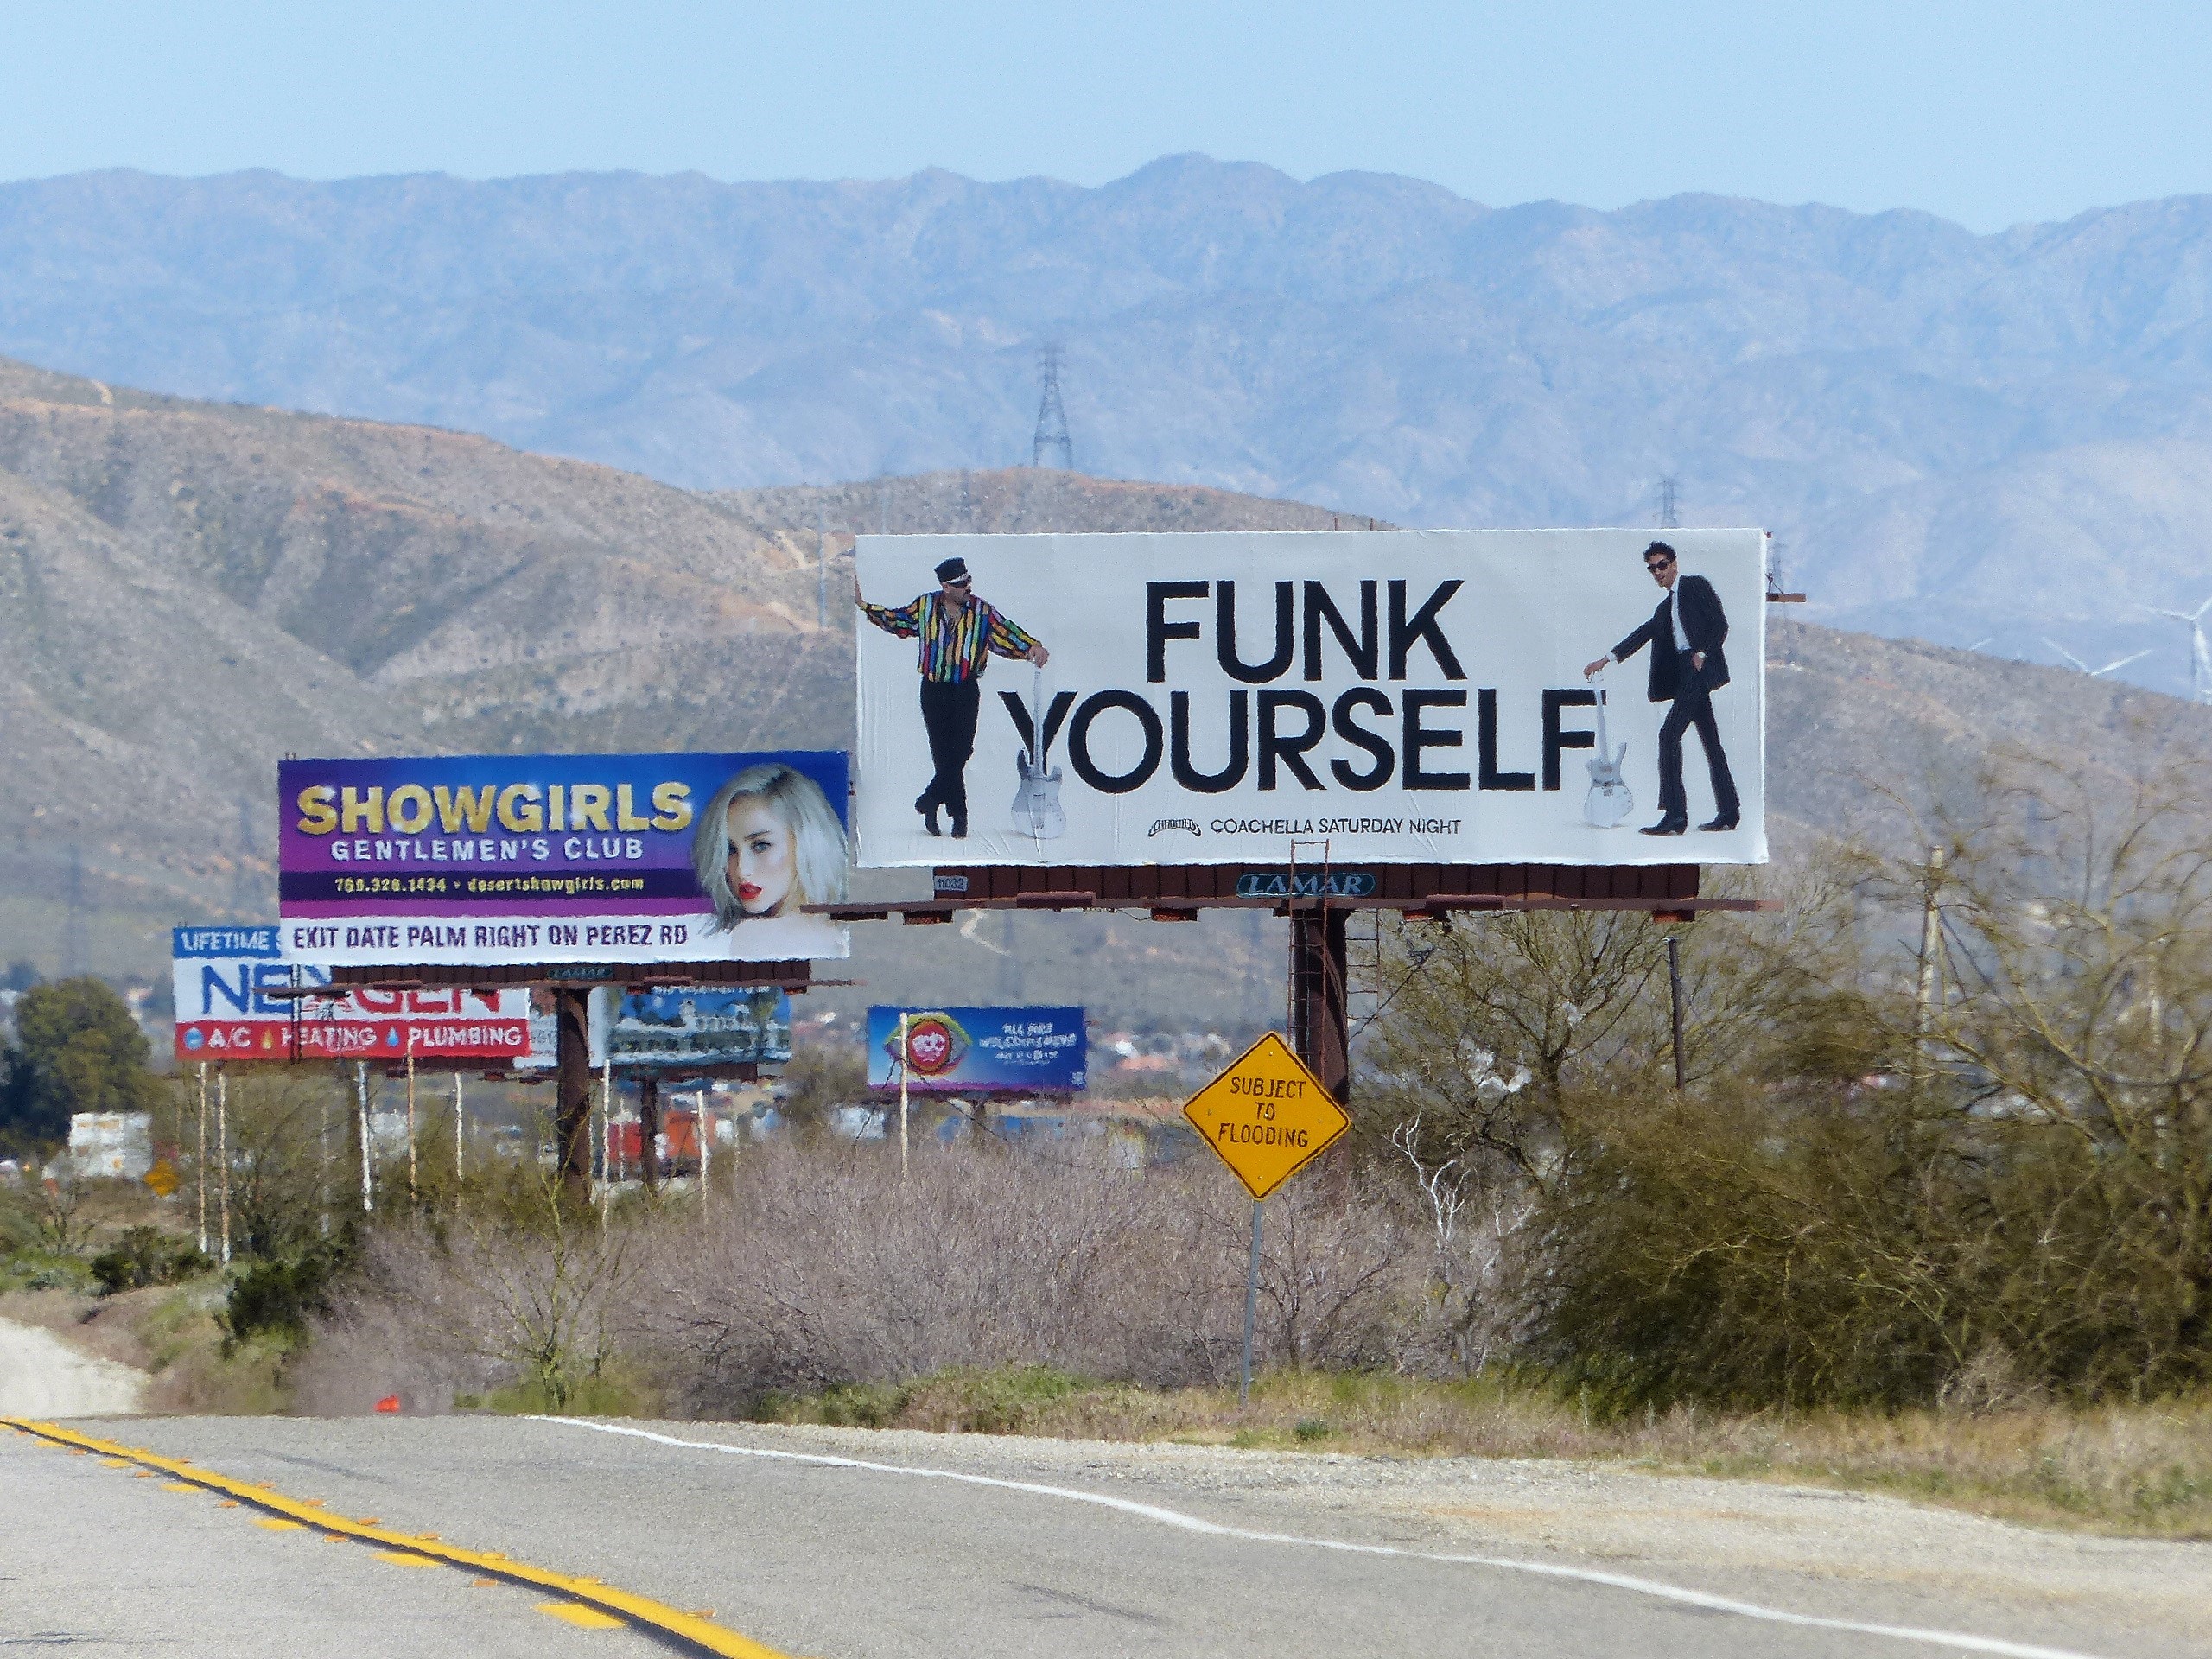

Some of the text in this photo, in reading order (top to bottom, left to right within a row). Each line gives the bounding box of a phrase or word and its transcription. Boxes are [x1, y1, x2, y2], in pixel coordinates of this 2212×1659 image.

[1146, 580, 1465, 685] FUNK
[998, 687, 1605, 792] YOURSELF
[296, 781, 692, 835] SHOWGIRLS
[1211, 818, 1461, 835] COACHELLA SATURDAY NIGHT
[331, 836, 644, 861] GENTLEMEN'S CLUB
[467, 876, 644, 894] desertshowgirls.com
[1248, 875, 1363, 894] LAMAR
[181, 931, 271, 951] LIFETIME
[293, 927, 339, 949] EXIT
[346, 926, 399, 948] DATE
[407, 925, 466, 947] PALM
[474, 925, 540, 947] RIGHT
[548, 925, 577, 946] ON
[586, 925, 652, 946] PEREZ
[659, 925, 688, 945] RD
[208, 1026, 251, 1049] A/C
[281, 1027, 377, 1046] HEATING
[409, 1026, 522, 1046] PLUMBING
[1230, 1077, 1306, 1098] SUBJECT
[1255, 1102, 1275, 1121] TO
[1218, 1123, 1308, 1147] FLOODING
